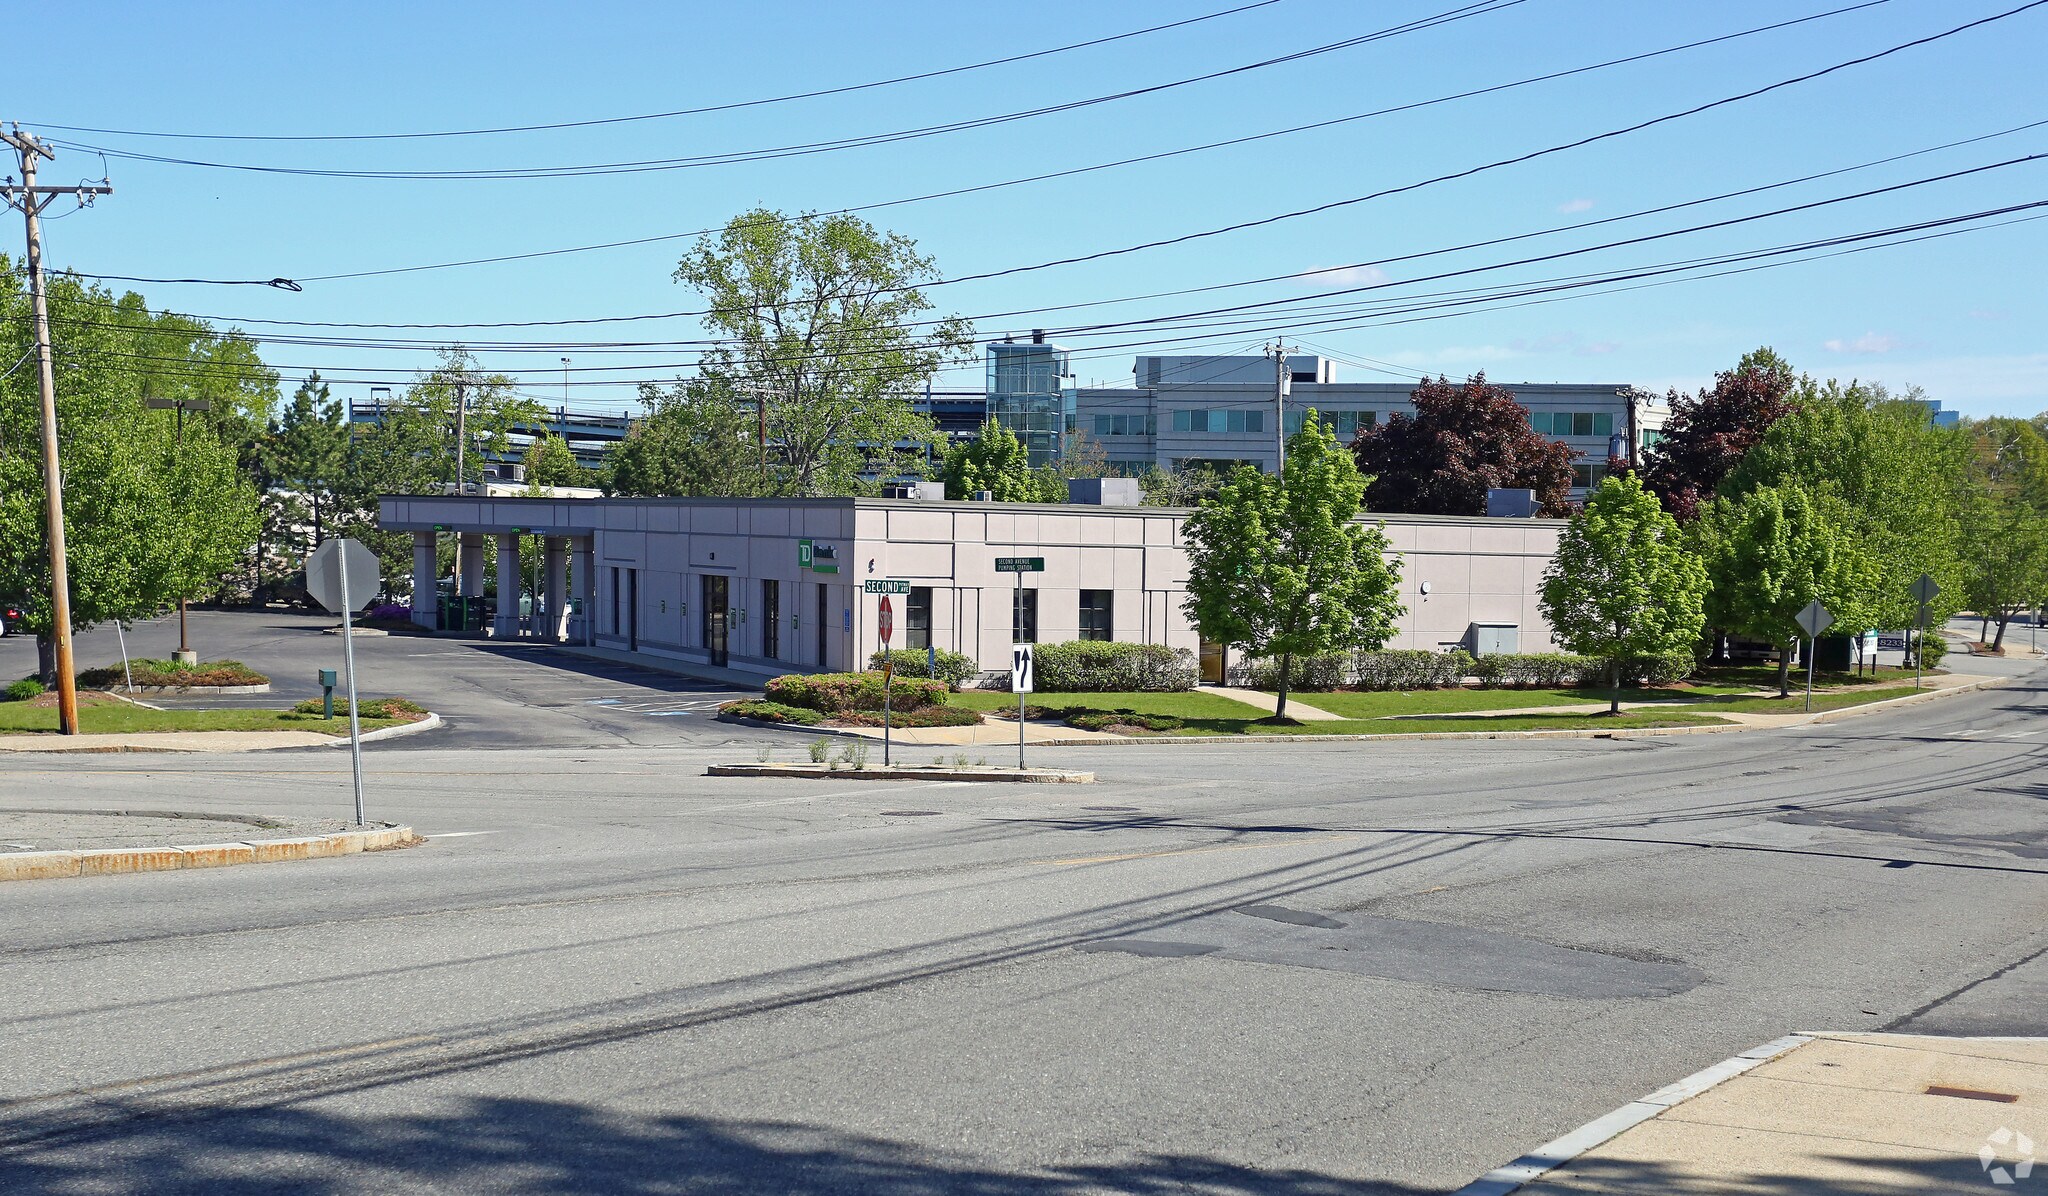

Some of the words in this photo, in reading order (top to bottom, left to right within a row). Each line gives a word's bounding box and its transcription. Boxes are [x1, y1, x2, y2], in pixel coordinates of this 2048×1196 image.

[799, 544, 811, 562] TD
[866, 581, 899, 593] SECOND
[880, 610, 892, 629] STOP
